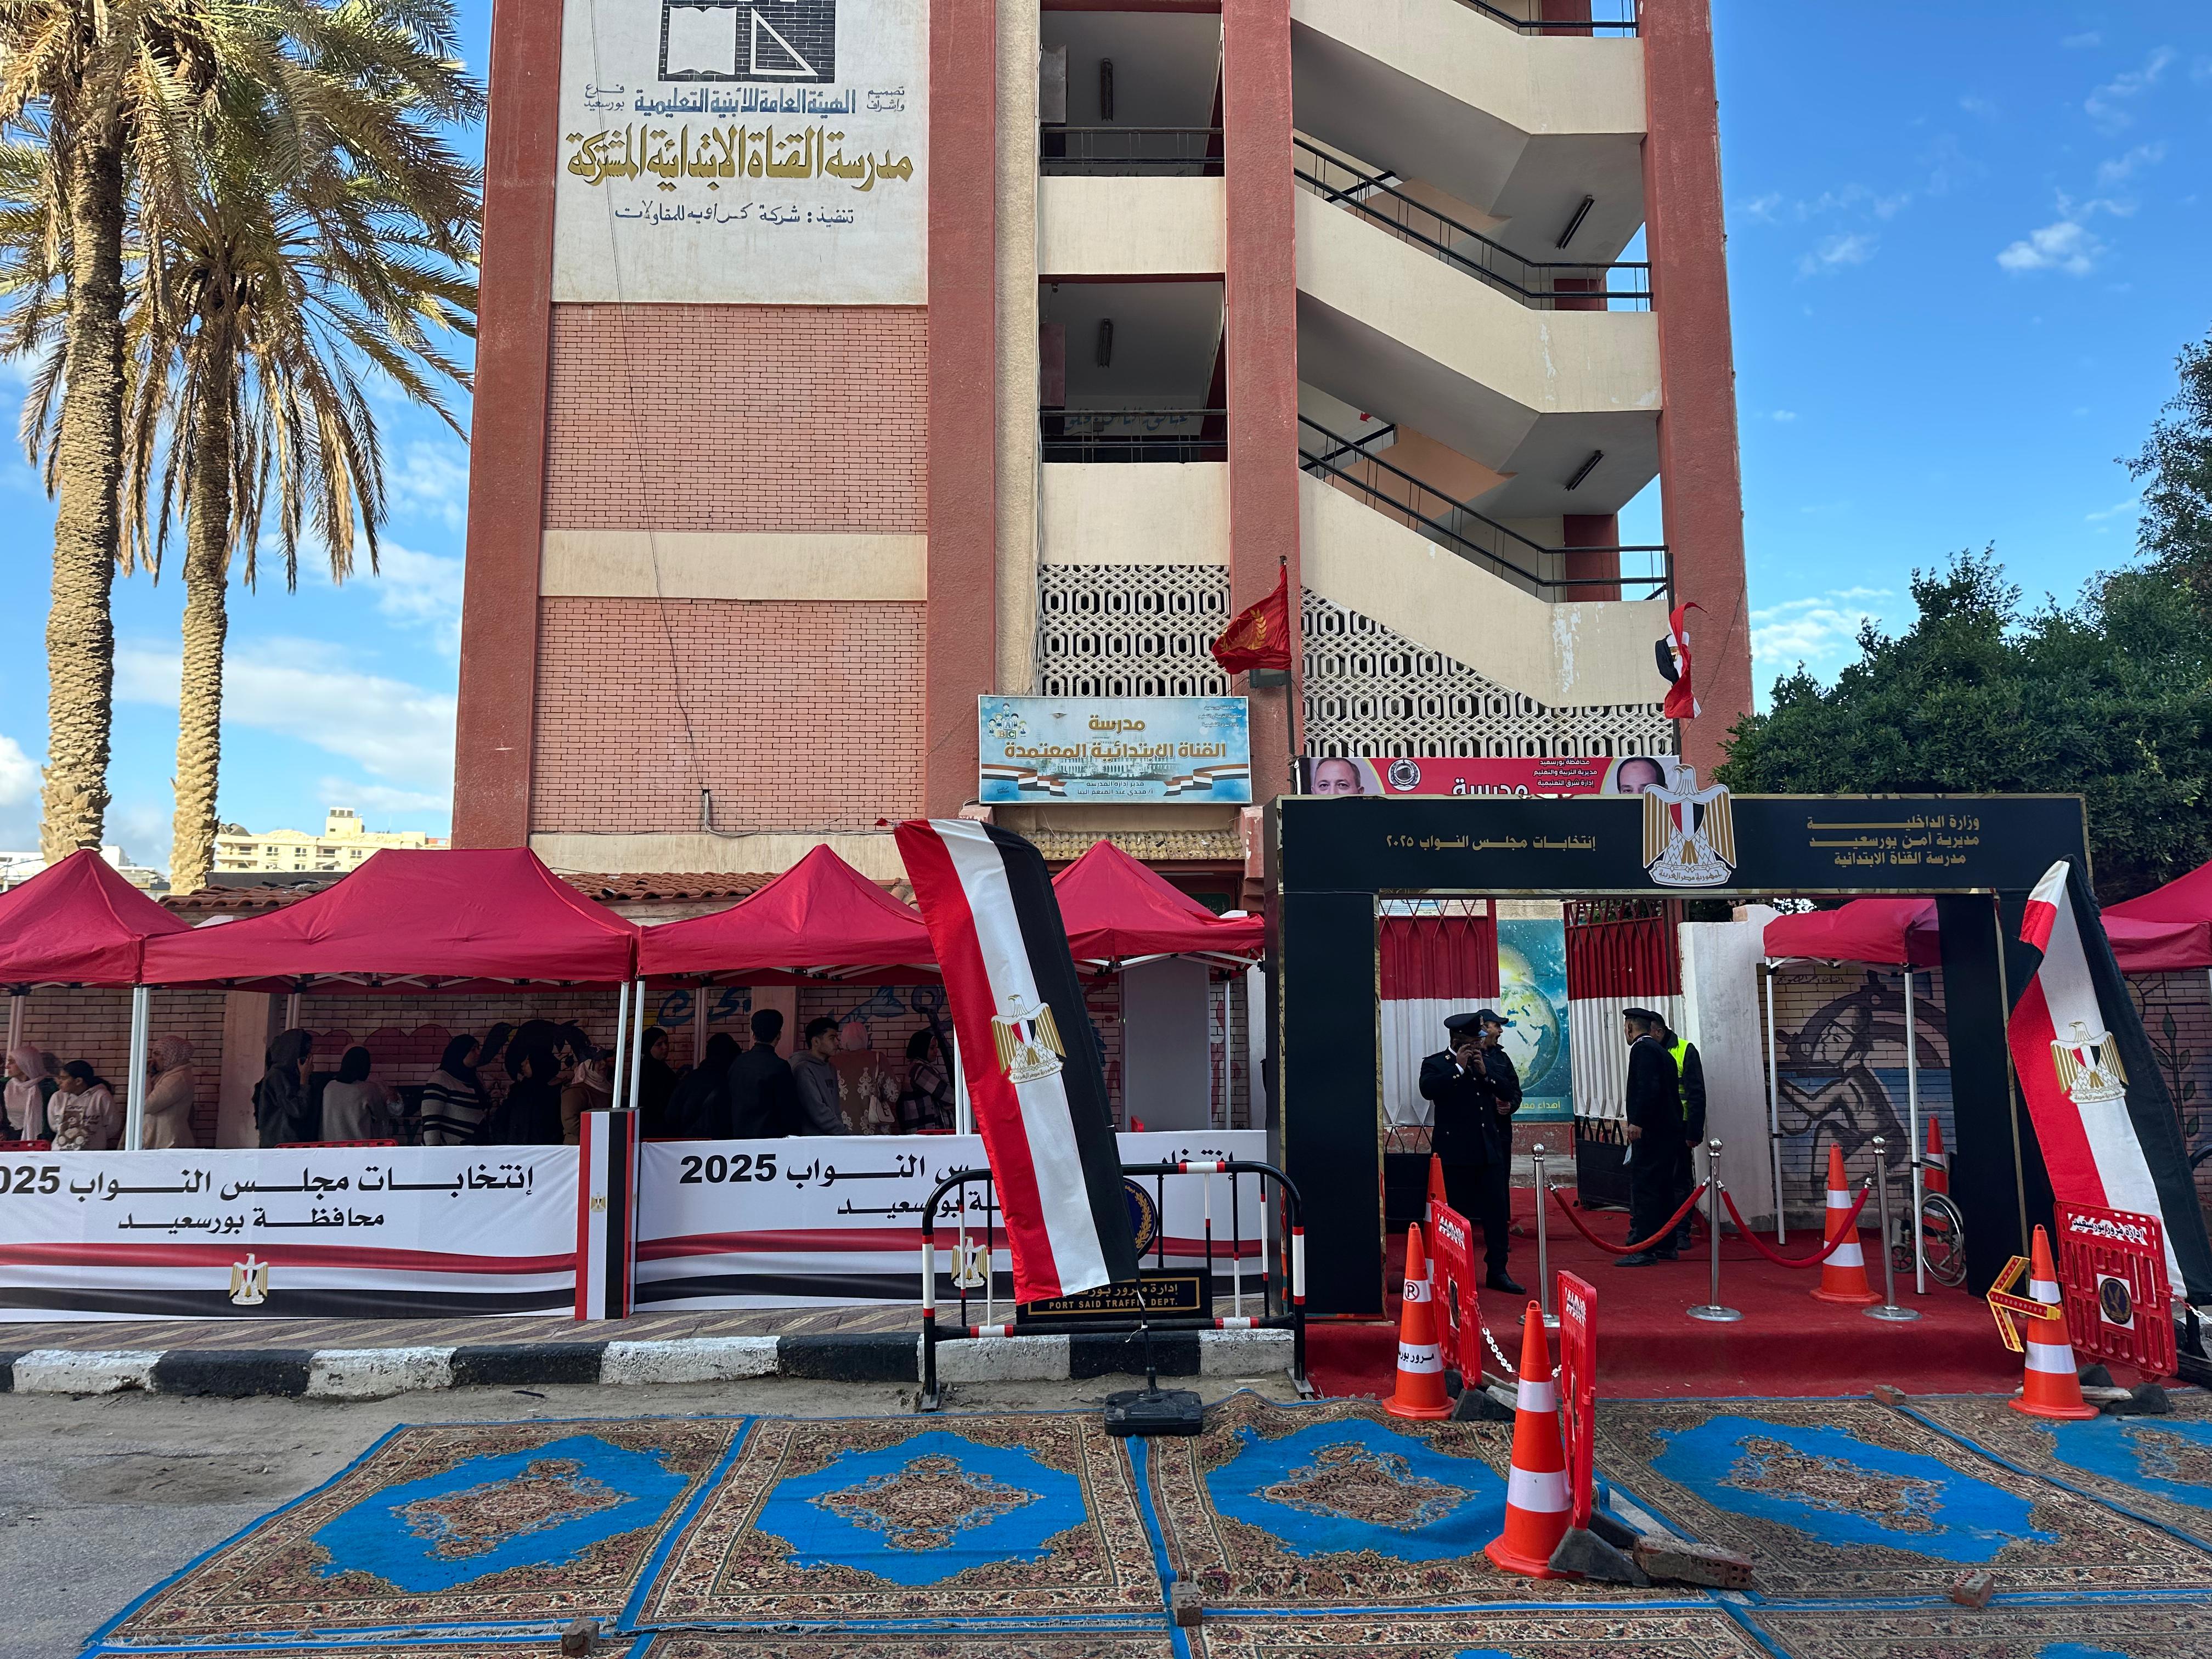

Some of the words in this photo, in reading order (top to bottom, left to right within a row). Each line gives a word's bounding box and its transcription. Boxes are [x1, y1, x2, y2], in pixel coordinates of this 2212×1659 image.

[585, 83, 624, 98] فرع
[867, 86, 905, 100] تصميم
[584, 100, 624, 111] بورسعيد
[634, 88, 709, 119] التعليمية
[759, 88, 806, 115] العامة
[807, 87, 856, 119] الهيئة
[566, 122, 647, 188] المشتركة
[648, 123, 746, 192] الابتدائية
[747, 124, 823, 180] القناة
[825, 131, 914, 192] مدرسة
[614, 200, 685, 225] للمقاولات
[759, 204, 800, 225] شركة
[816, 206, 854, 228] تنفيذ
[1088, 714, 1146, 734] مدرسة
[1003, 741, 1087, 759] المعتمدة
[1090, 740, 1174, 762] الابتدائية
[1177, 741, 1227, 758] القناة
[1807, 815, 1945, 831] الداخلية
[1949, 815, 1980, 830] وزارة
[1386, 835, 1414, 847] ٢٠٢٥
[1419, 835, 1469, 850] النواب
[1472, 835, 1528, 851] مجلس
[1533, 835, 1596, 851] إنتخابات
[1809, 835, 1897, 849] بورسعيد
[1902, 831, 1932, 849] أمن
[1937, 832, 1979, 848] مديرية
[1835, 851, 1885, 867] الابتدائية
[1890, 851, 1921, 865] القناة
[1926, 851, 1966, 866] مدرسة
[680, 1154, 776, 1184] 2025
[786, 1155, 925, 1188] النواب
[69, 1170, 212, 1201] النواب
[219, 1166, 349, 1200] مجلس
[358, 1165, 534, 1197] إنتخابات
[117, 1212, 244, 1233] بورسعيد
[252, 1208, 385, 1228] محافظة
[1150, 1284, 1178, 1296] إدارة
[1049, 1301, 1074, 1310] PORT
[1079, 1300, 1101, 1308] SAID
[1105, 1298, 1146, 1307] TRAFFI
[1151, 1297, 1178, 1306] DEPT.
[1410, 1353, 1434, 1364] مرور
